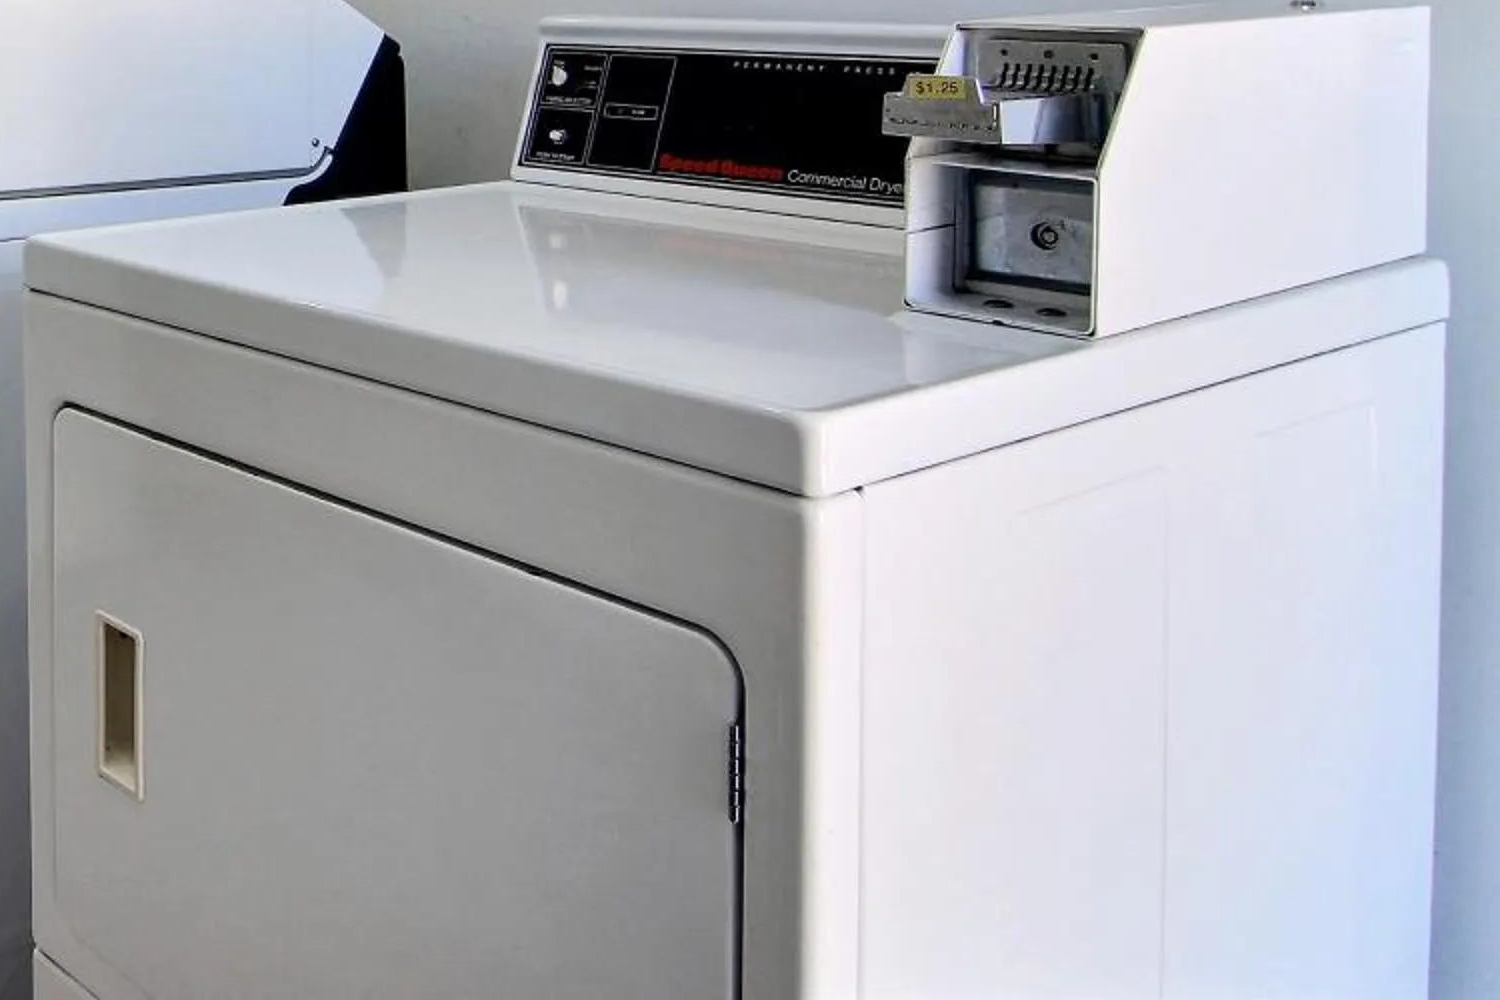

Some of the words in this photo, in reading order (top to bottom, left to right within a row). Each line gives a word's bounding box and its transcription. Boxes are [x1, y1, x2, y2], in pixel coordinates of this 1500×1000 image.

[915, 81, 959, 95] $1.25
[787, 169, 867, 190] Commercial
[869, 177, 904, 195] Drye
